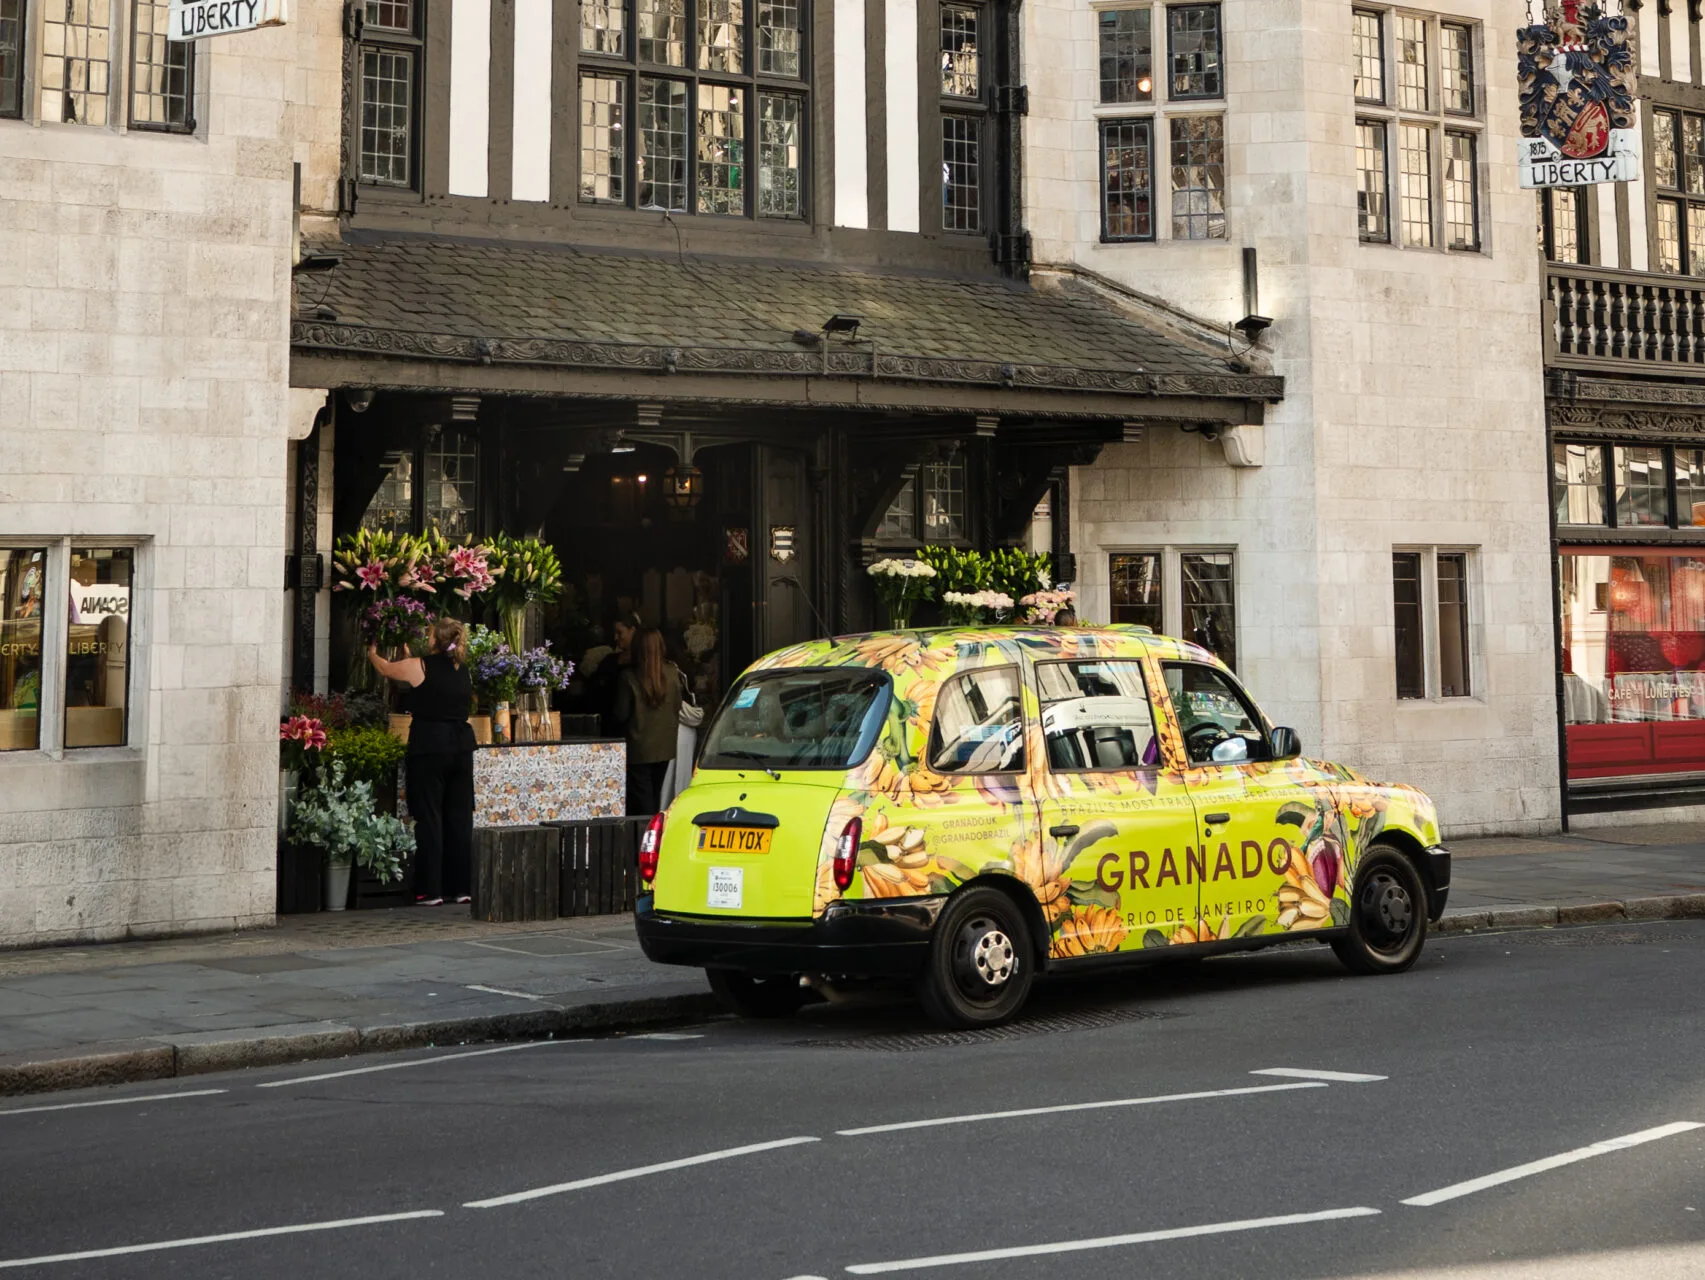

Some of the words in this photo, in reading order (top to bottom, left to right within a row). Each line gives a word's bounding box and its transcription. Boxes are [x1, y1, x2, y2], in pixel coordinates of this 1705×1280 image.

[1529, 141, 1547, 156] 1875
[69, 642, 124, 655] LIBERTY
[1645, 686, 1690, 699] LUNETTES
[1121, 799, 1154, 811] MOST
[942, 816, 997, 829] GRANADO.UK
[739, 831, 765, 850] YOX
[933, 828, 1010, 845] @GRANADOBRAZIL
[1096, 837, 1293, 893] GRANADO
[1127, 910, 1156, 926] RIO
[1165, 907, 1184, 922] DE
[1193, 898, 1266, 920] JANEIRO
